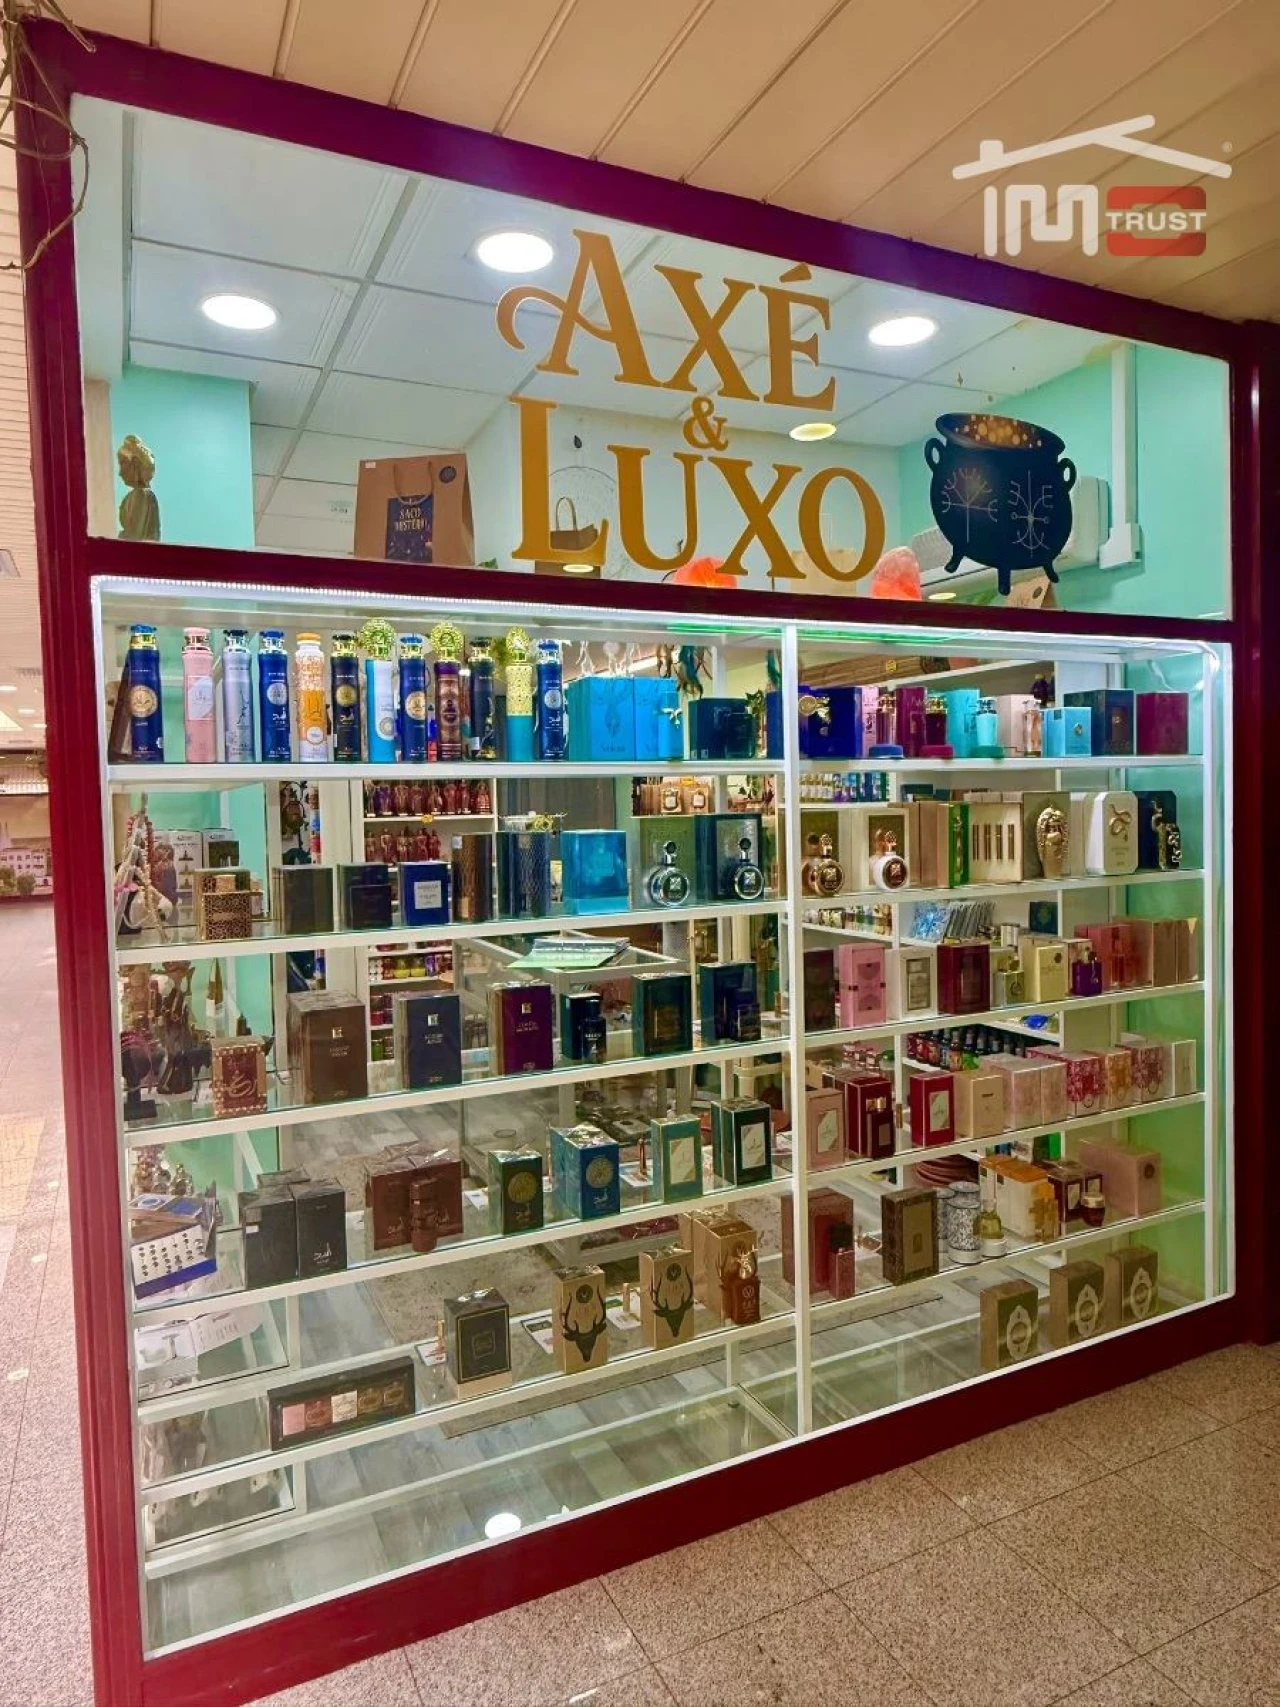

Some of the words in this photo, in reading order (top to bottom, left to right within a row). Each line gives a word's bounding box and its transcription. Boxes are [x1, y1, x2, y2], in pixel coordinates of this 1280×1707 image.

[495, 228, 837, 412] AXÉ
[508, 393, 886, 583] LUXO
[682, 396, 729, 452] &
